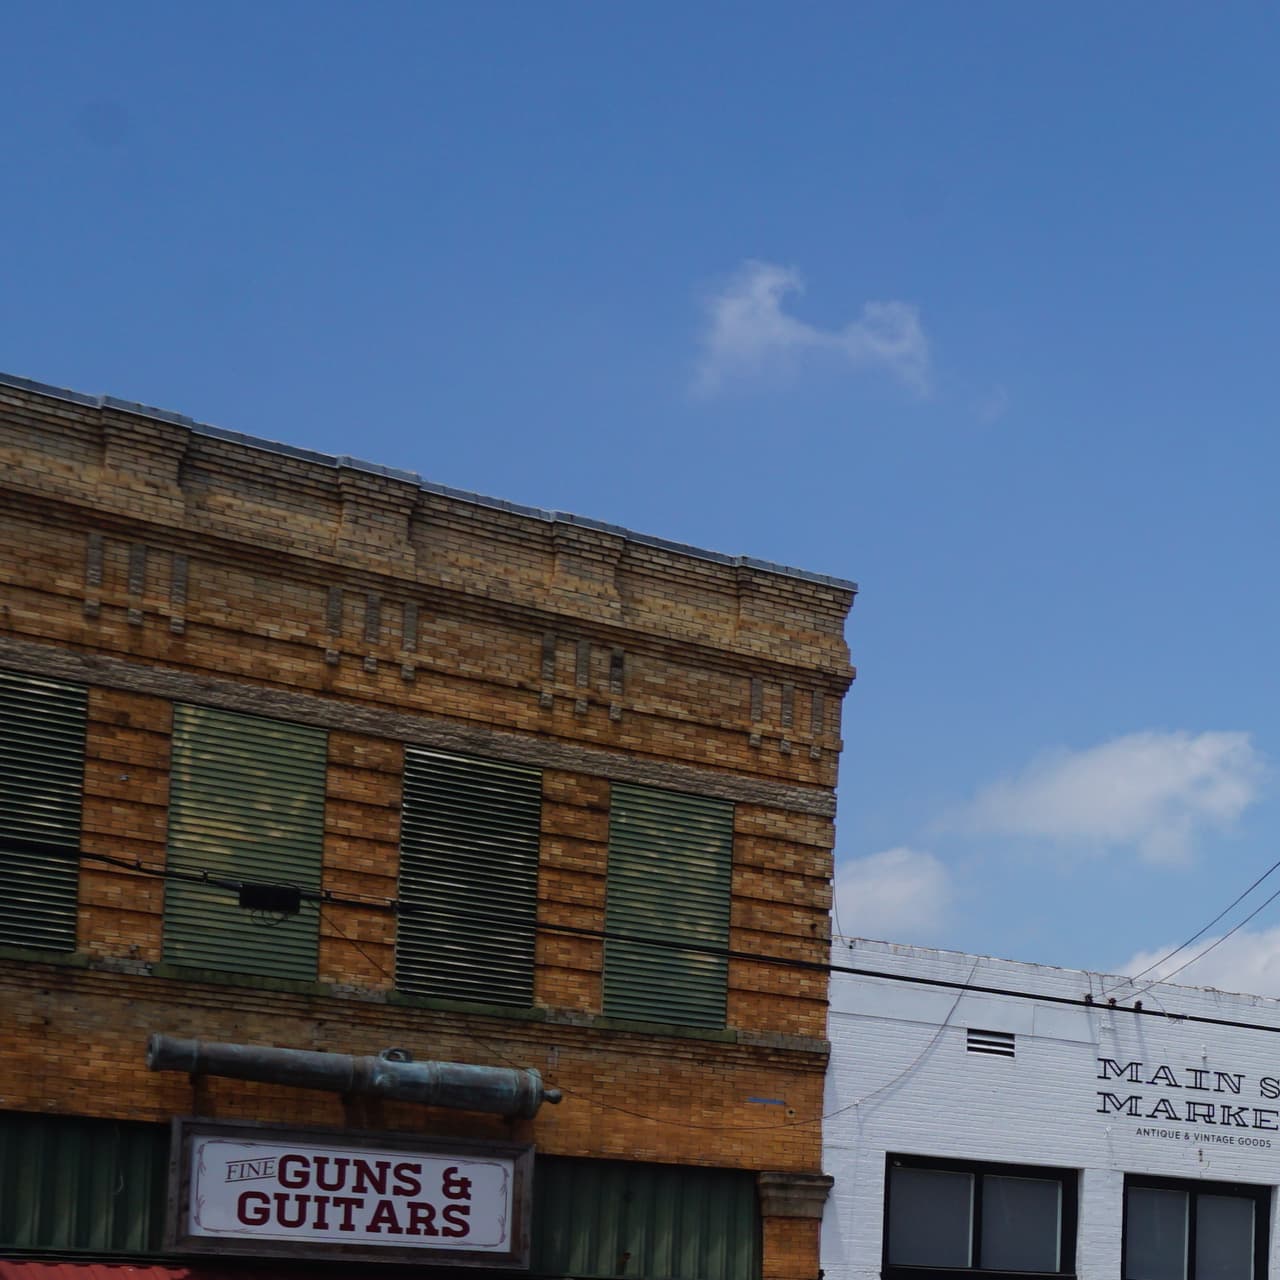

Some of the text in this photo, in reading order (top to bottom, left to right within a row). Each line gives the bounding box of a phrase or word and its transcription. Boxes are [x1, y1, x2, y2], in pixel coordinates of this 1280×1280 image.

[1097, 1058, 1246, 1094] MAIN
[1136, 1127, 1272, 1149] ANTIQUE & VINTAGE GOODS
[226, 1154, 473, 1200] FINE GUNS &
[237, 1191, 471, 1238] GUITARS
